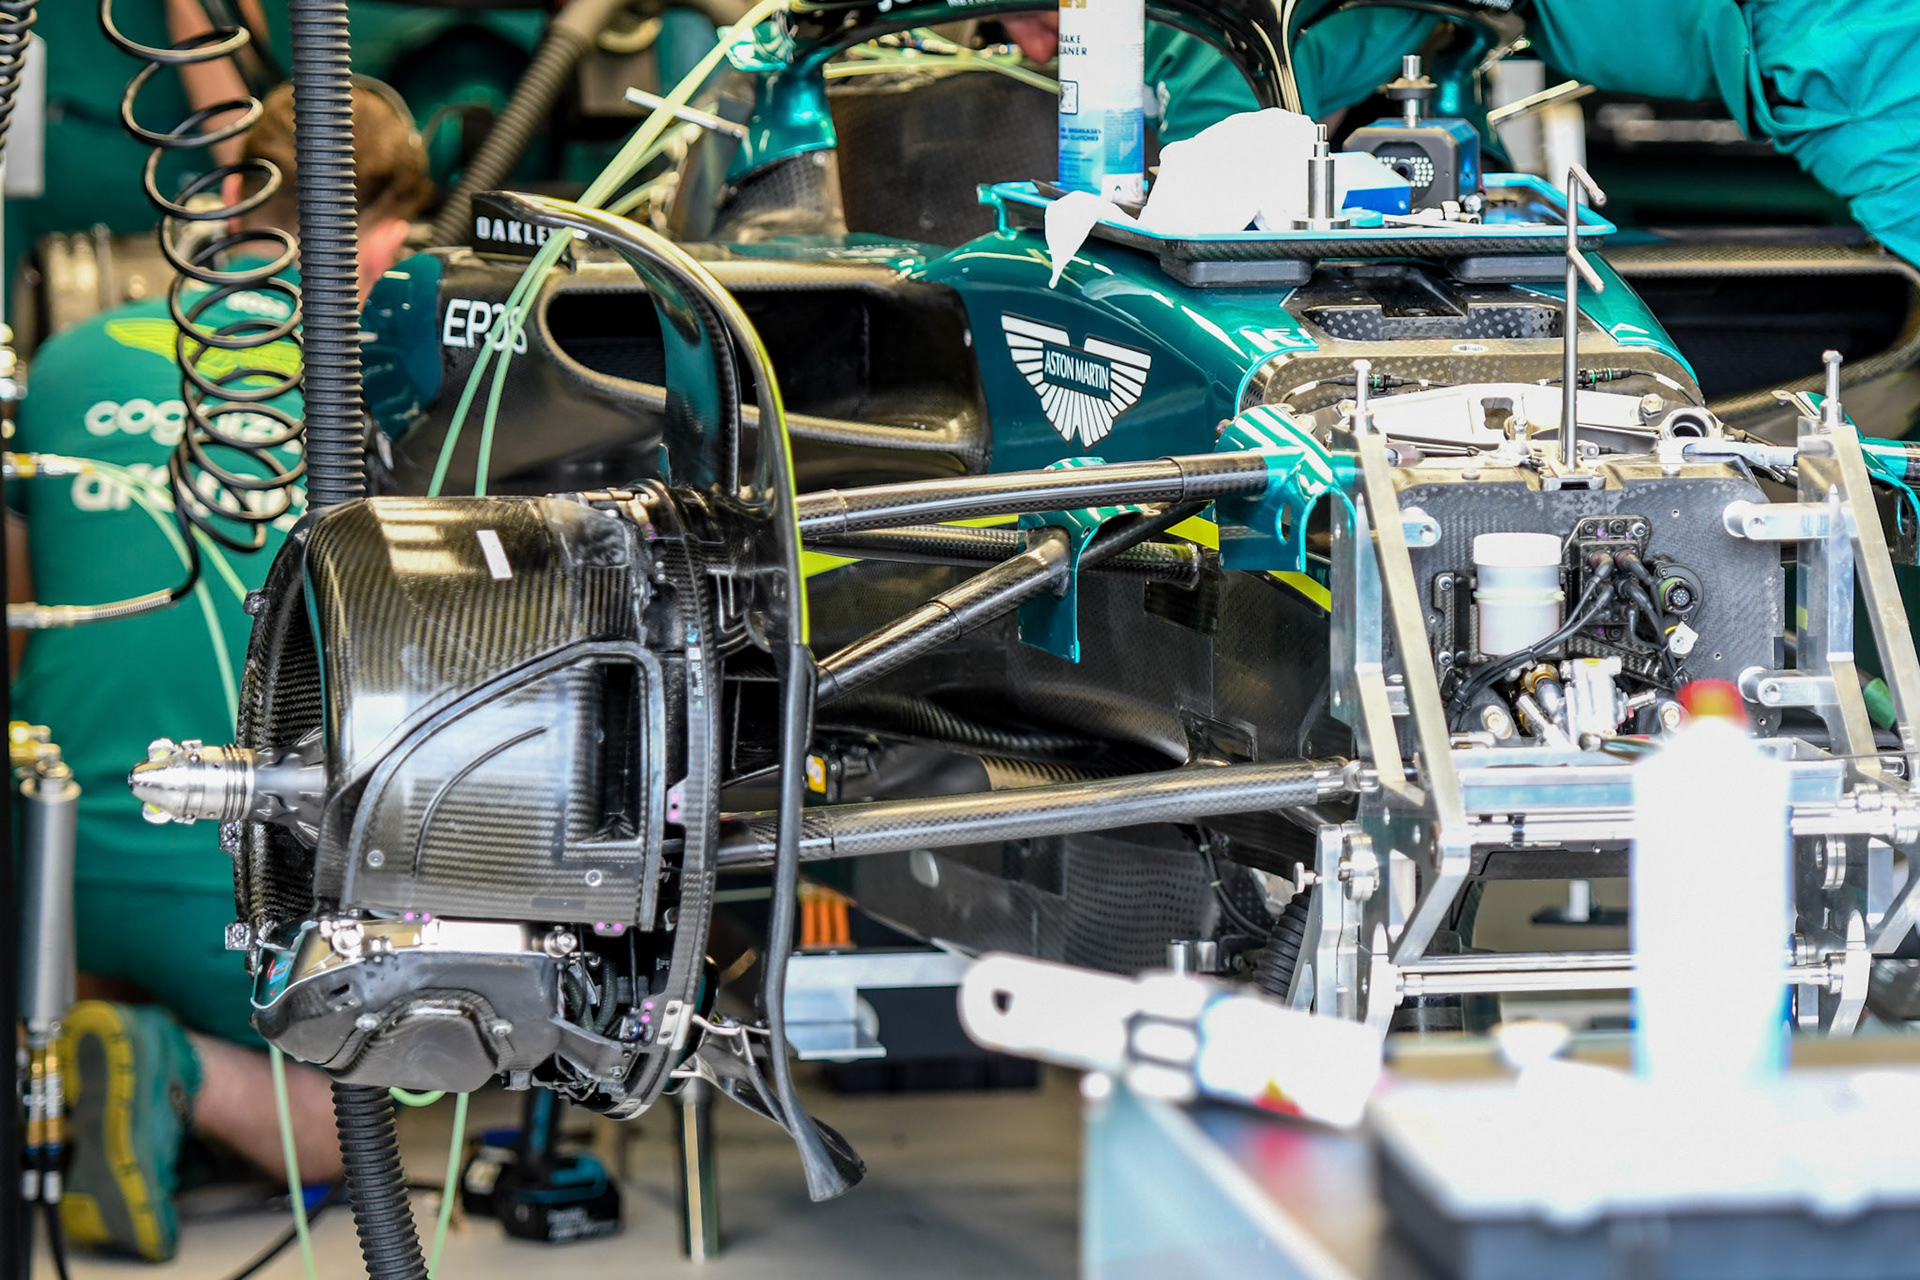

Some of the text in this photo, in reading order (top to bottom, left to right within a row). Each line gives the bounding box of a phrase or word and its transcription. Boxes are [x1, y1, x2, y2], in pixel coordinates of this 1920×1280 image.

[476, 216, 556, 246] OAKLE
[1044, 350, 1109, 391] ASTON MARTIN
